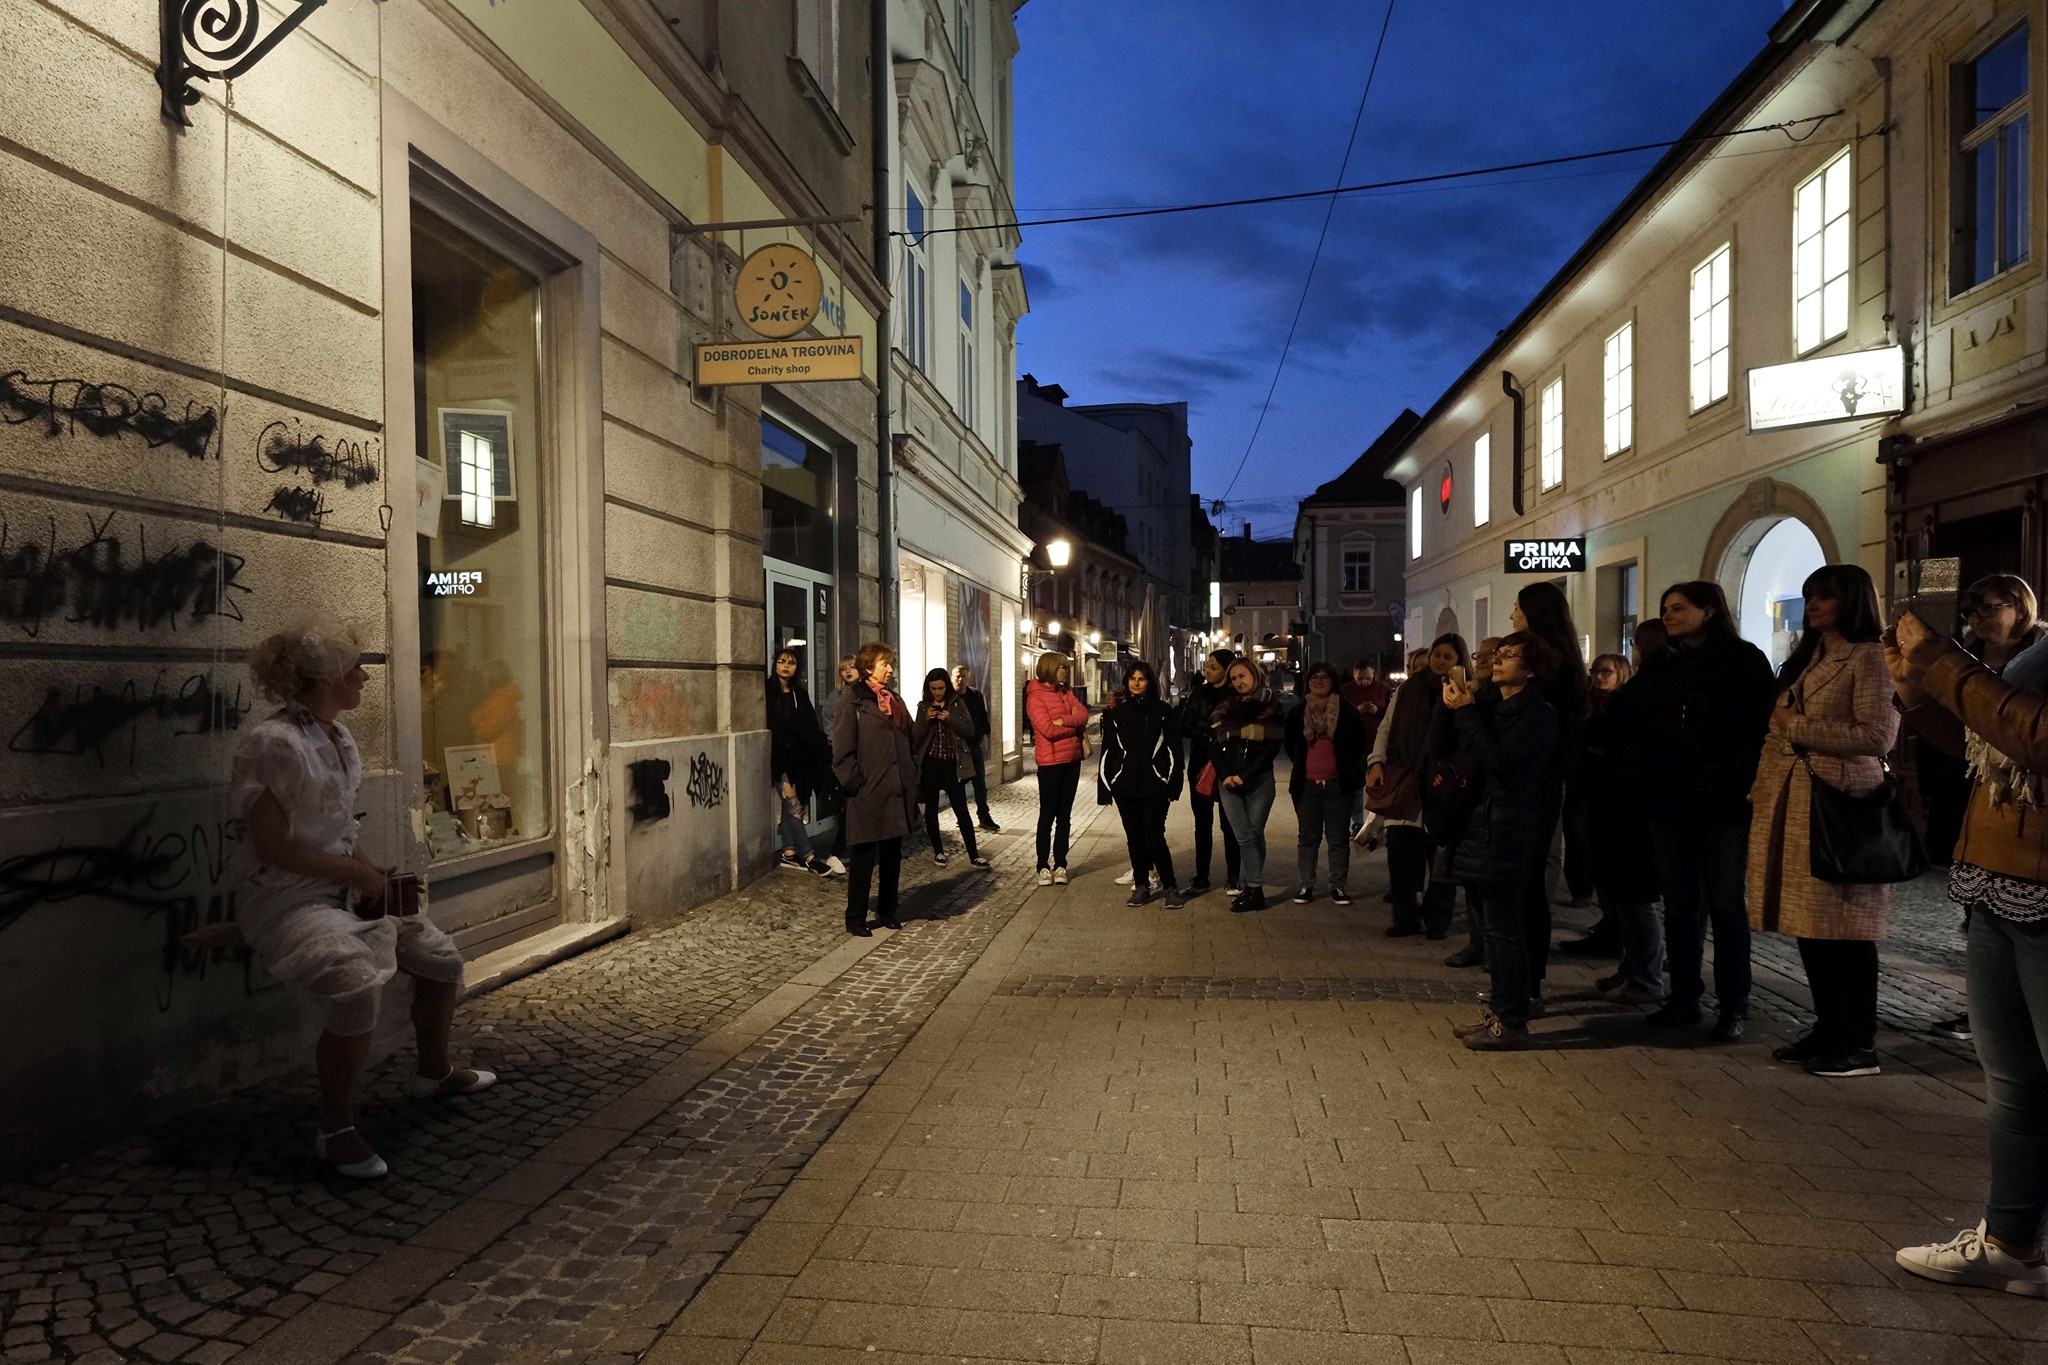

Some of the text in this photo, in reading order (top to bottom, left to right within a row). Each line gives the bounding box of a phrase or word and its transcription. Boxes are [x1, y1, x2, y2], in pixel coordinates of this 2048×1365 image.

[703, 344, 855, 362] DOBRODELNA TRGOVINA
[747, 364, 811, 376] Charity shop
[1509, 541, 1581, 557] PRIMA
[1519, 556, 1571, 570] OPTIKA
